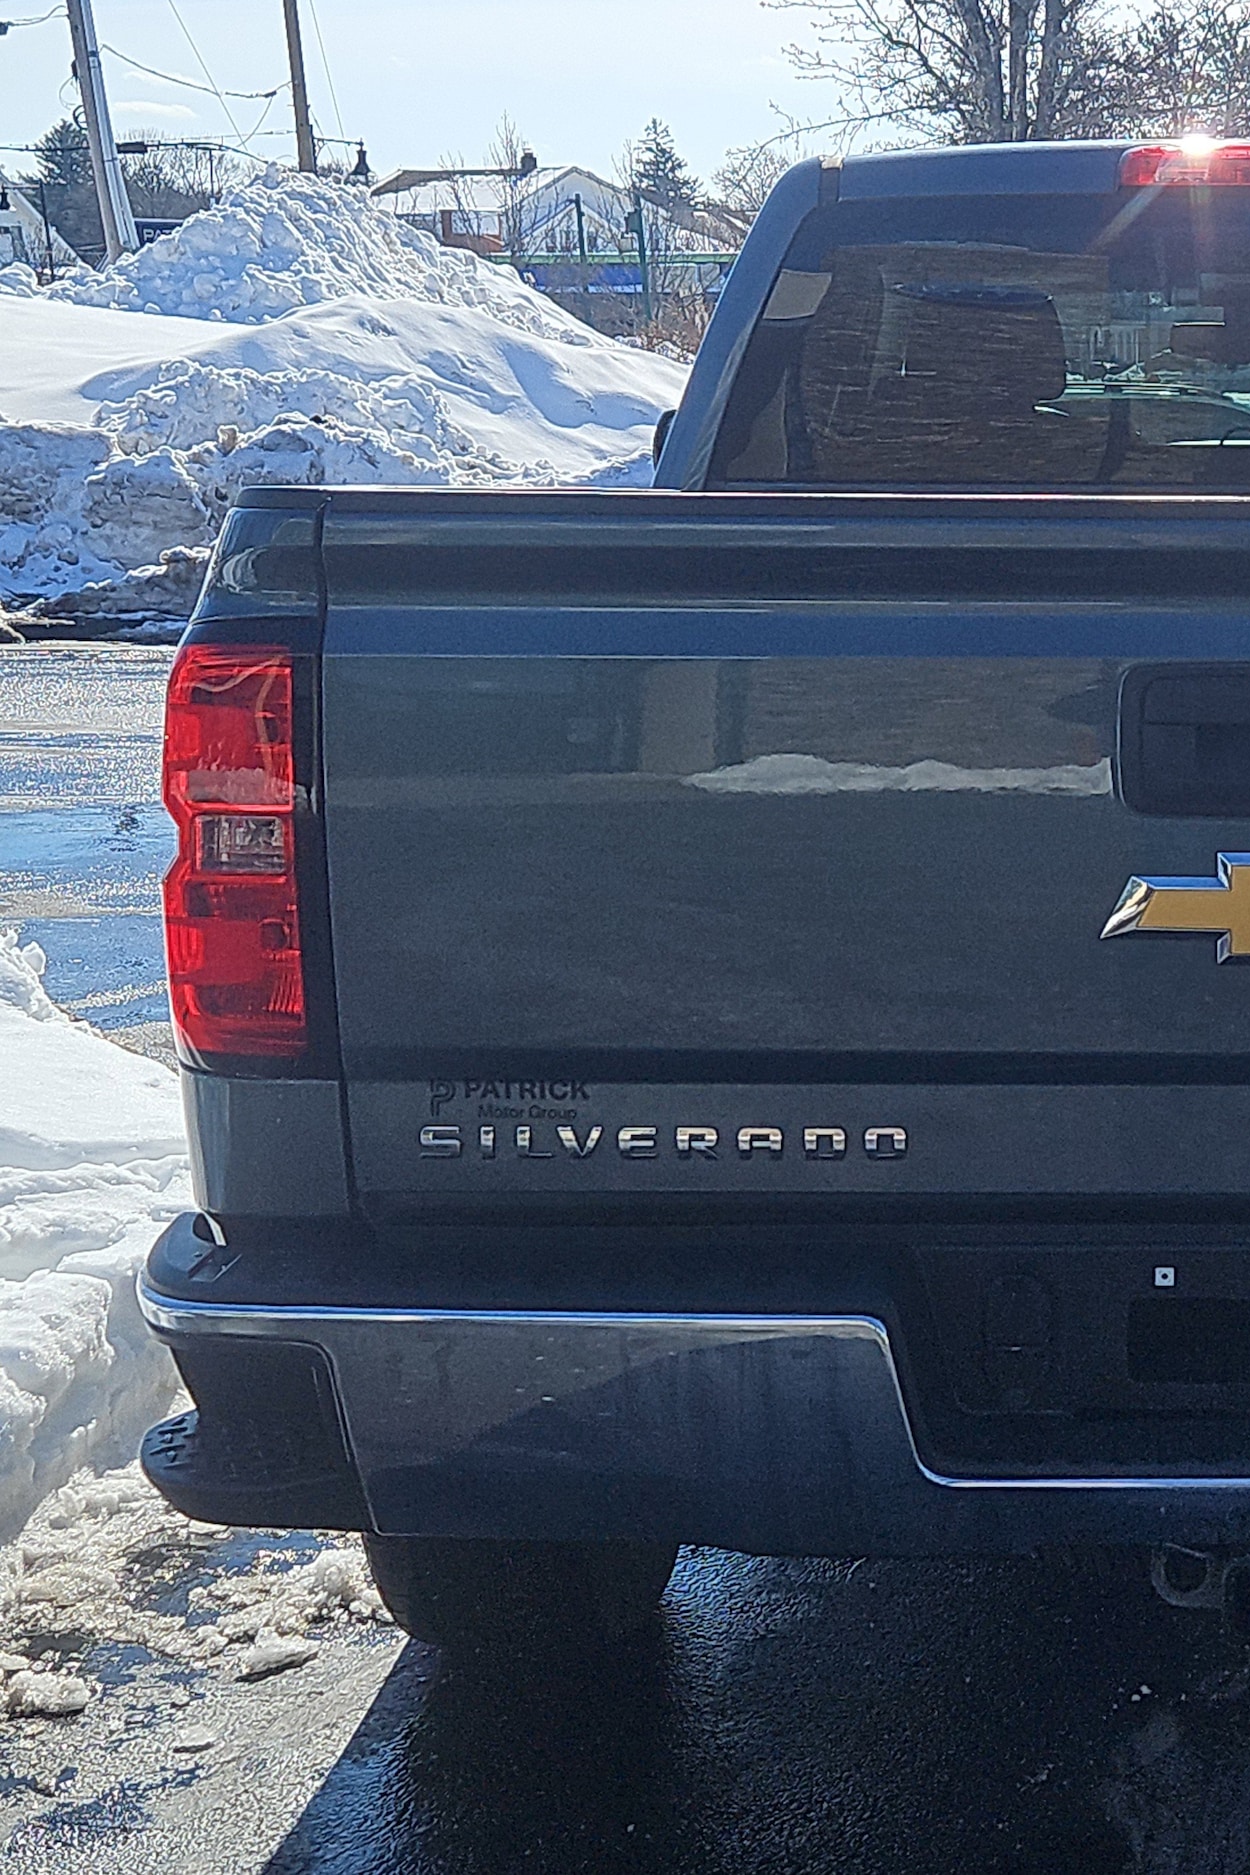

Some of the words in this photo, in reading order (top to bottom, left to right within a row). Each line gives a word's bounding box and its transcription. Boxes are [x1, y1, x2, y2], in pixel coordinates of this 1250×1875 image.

[465, 1079, 590, 1101] PATRICK
[478, 1104, 524, 1119] Motor
[529, 1105, 578, 1120] Group
[419, 1125, 908, 1159] SILVERADO
